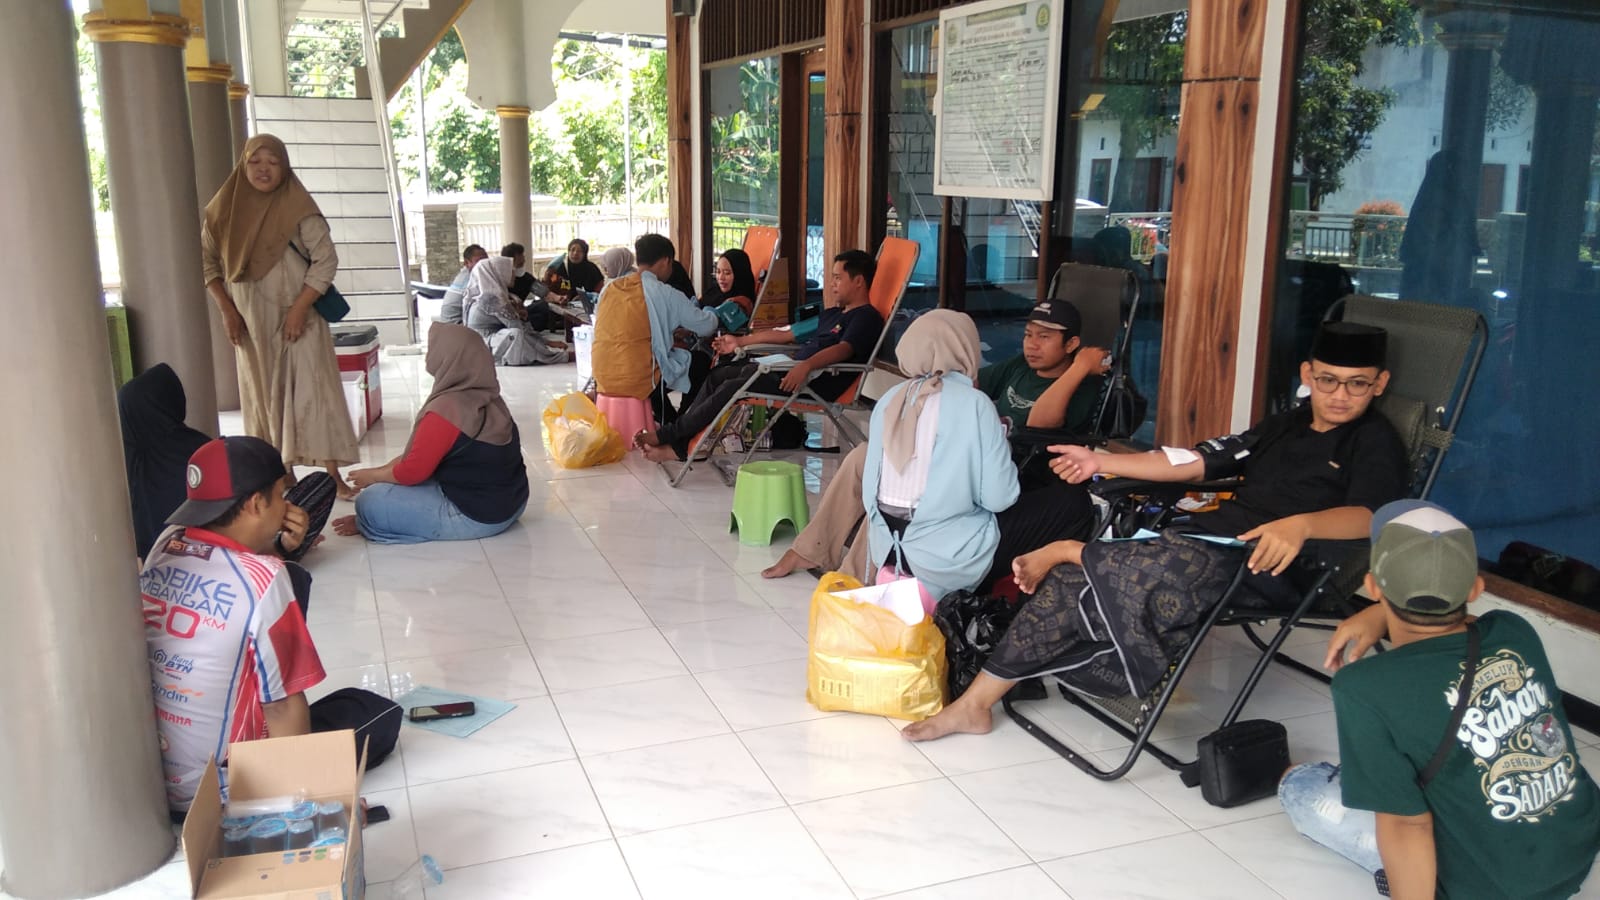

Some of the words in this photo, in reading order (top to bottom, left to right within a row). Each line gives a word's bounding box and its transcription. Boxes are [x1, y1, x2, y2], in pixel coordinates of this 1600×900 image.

[141, 592, 201, 639] 20
[201, 615, 226, 631] KM
[166, 660, 193, 674] BTN
[152, 682, 188, 703] andiri
[1456, 680, 1549, 759] Sabar
[1489, 761, 1569, 820] SADAR
